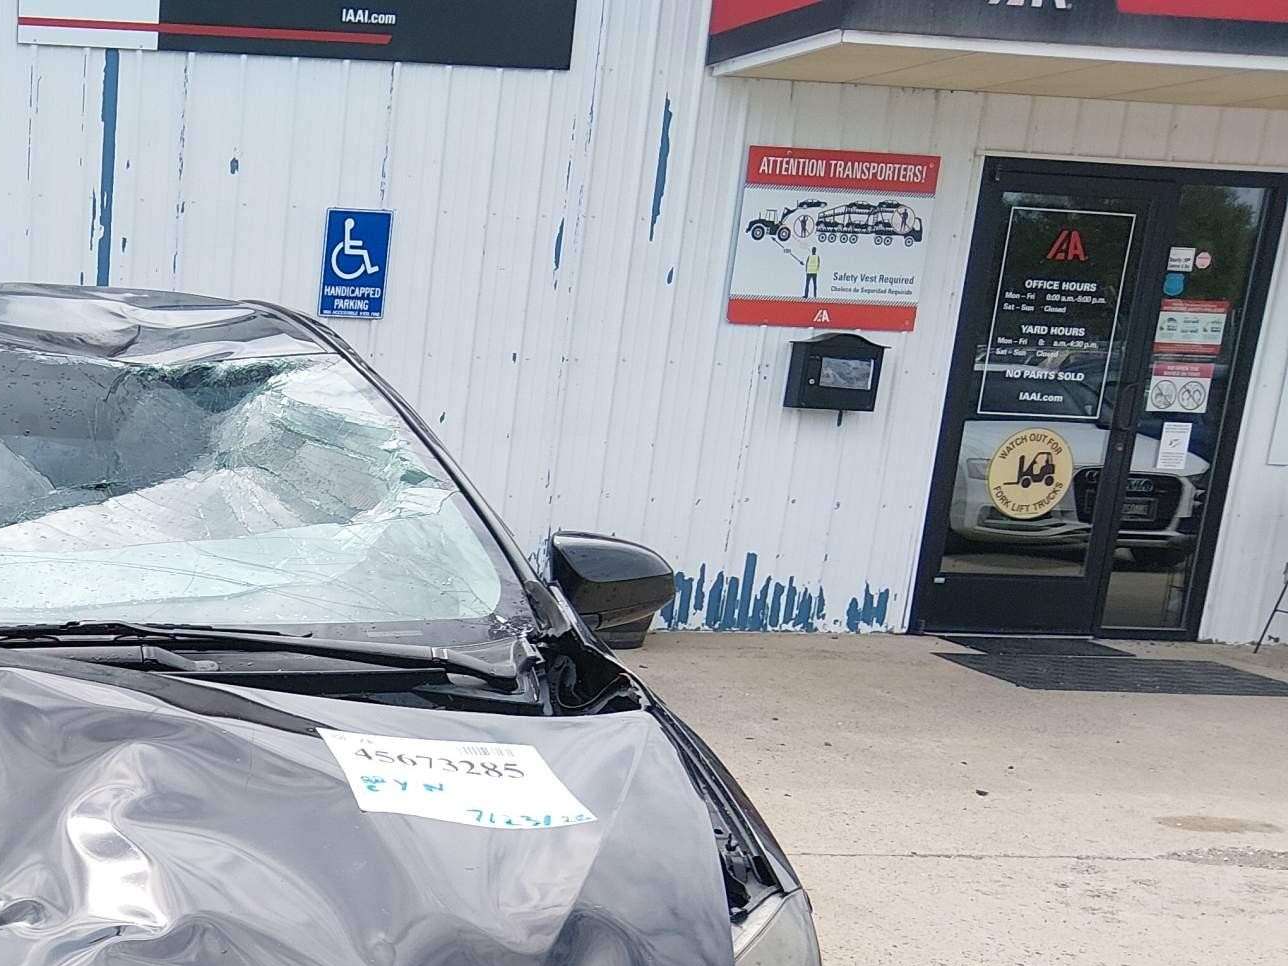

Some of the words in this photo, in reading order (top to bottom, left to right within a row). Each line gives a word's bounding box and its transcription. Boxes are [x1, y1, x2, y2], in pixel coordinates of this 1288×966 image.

[341, 8, 396, 25] IAAI.com
[759, 156, 826, 177] ATTENTION
[829, 160, 927, 183] TRANSPORTERS!
[832, 272, 858, 283] Safety
[860, 273, 877, 283] Vest
[878, 274, 915, 286] Required
[324, 285, 381, 298] HANDICAPPED
[1024, 279, 1060, 290] OFFICE
[1061, 282, 1097, 292] HOURS
[1005, 291, 1020, 299] Mon
[1026, 292, 1036, 300] Fri
[334, 299, 369, 311] PARKING
[1003, 303, 1015, 311] Sat
[1044, 305, 1067, 313] Closed
[1021, 325, 1048, 335] YARD
[1050, 326, 1086, 337] HOURS
[997, 336, 1013, 344] Mon
[1018, 337, 1028, 345] Fri
[995, 347, 1007, 355] Sat
[1005, 369, 1021, 378] NO
[1023, 370, 1055, 380] PARTS
[1057, 371, 1085, 381] SOLD
[1019, 391, 1063, 402] IAAI.com
[999, 434, 1028, 460] WATCH
[1028, 433, 1048, 443] OUT
[1047, 438, 1063, 455] FOR
[993, 485, 1013, 508] FORK
[1011, 502, 1030, 512] LIFT
[1032, 482, 1064, 511] TRUCKS
[354, 748, 525, 779] 45673285
